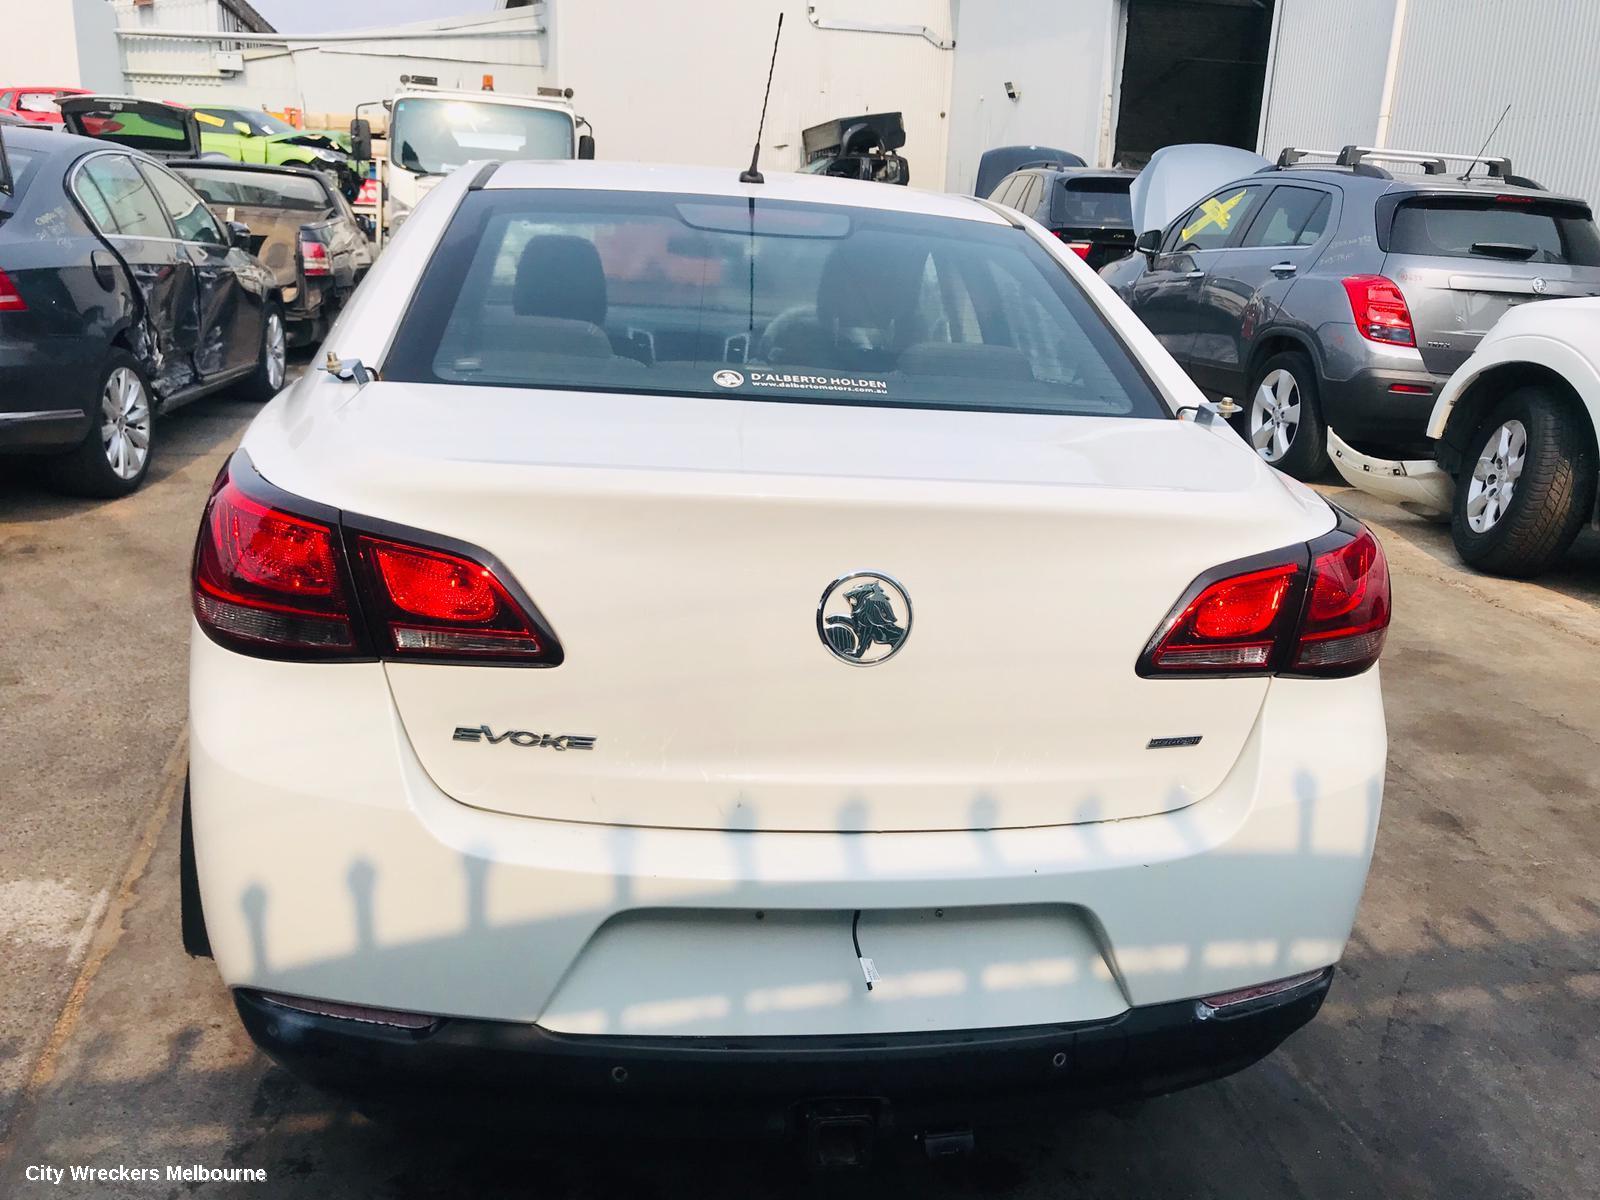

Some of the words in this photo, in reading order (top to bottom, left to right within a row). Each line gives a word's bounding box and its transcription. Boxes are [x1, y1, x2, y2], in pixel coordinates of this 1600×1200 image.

[751, 372, 828, 385] D'ALBERTO
[830, 376, 887, 389] HOLDEN
[752, 381, 888, 394] www.dalbertomotors.com.au
[452, 724, 597, 751] EVOKE
